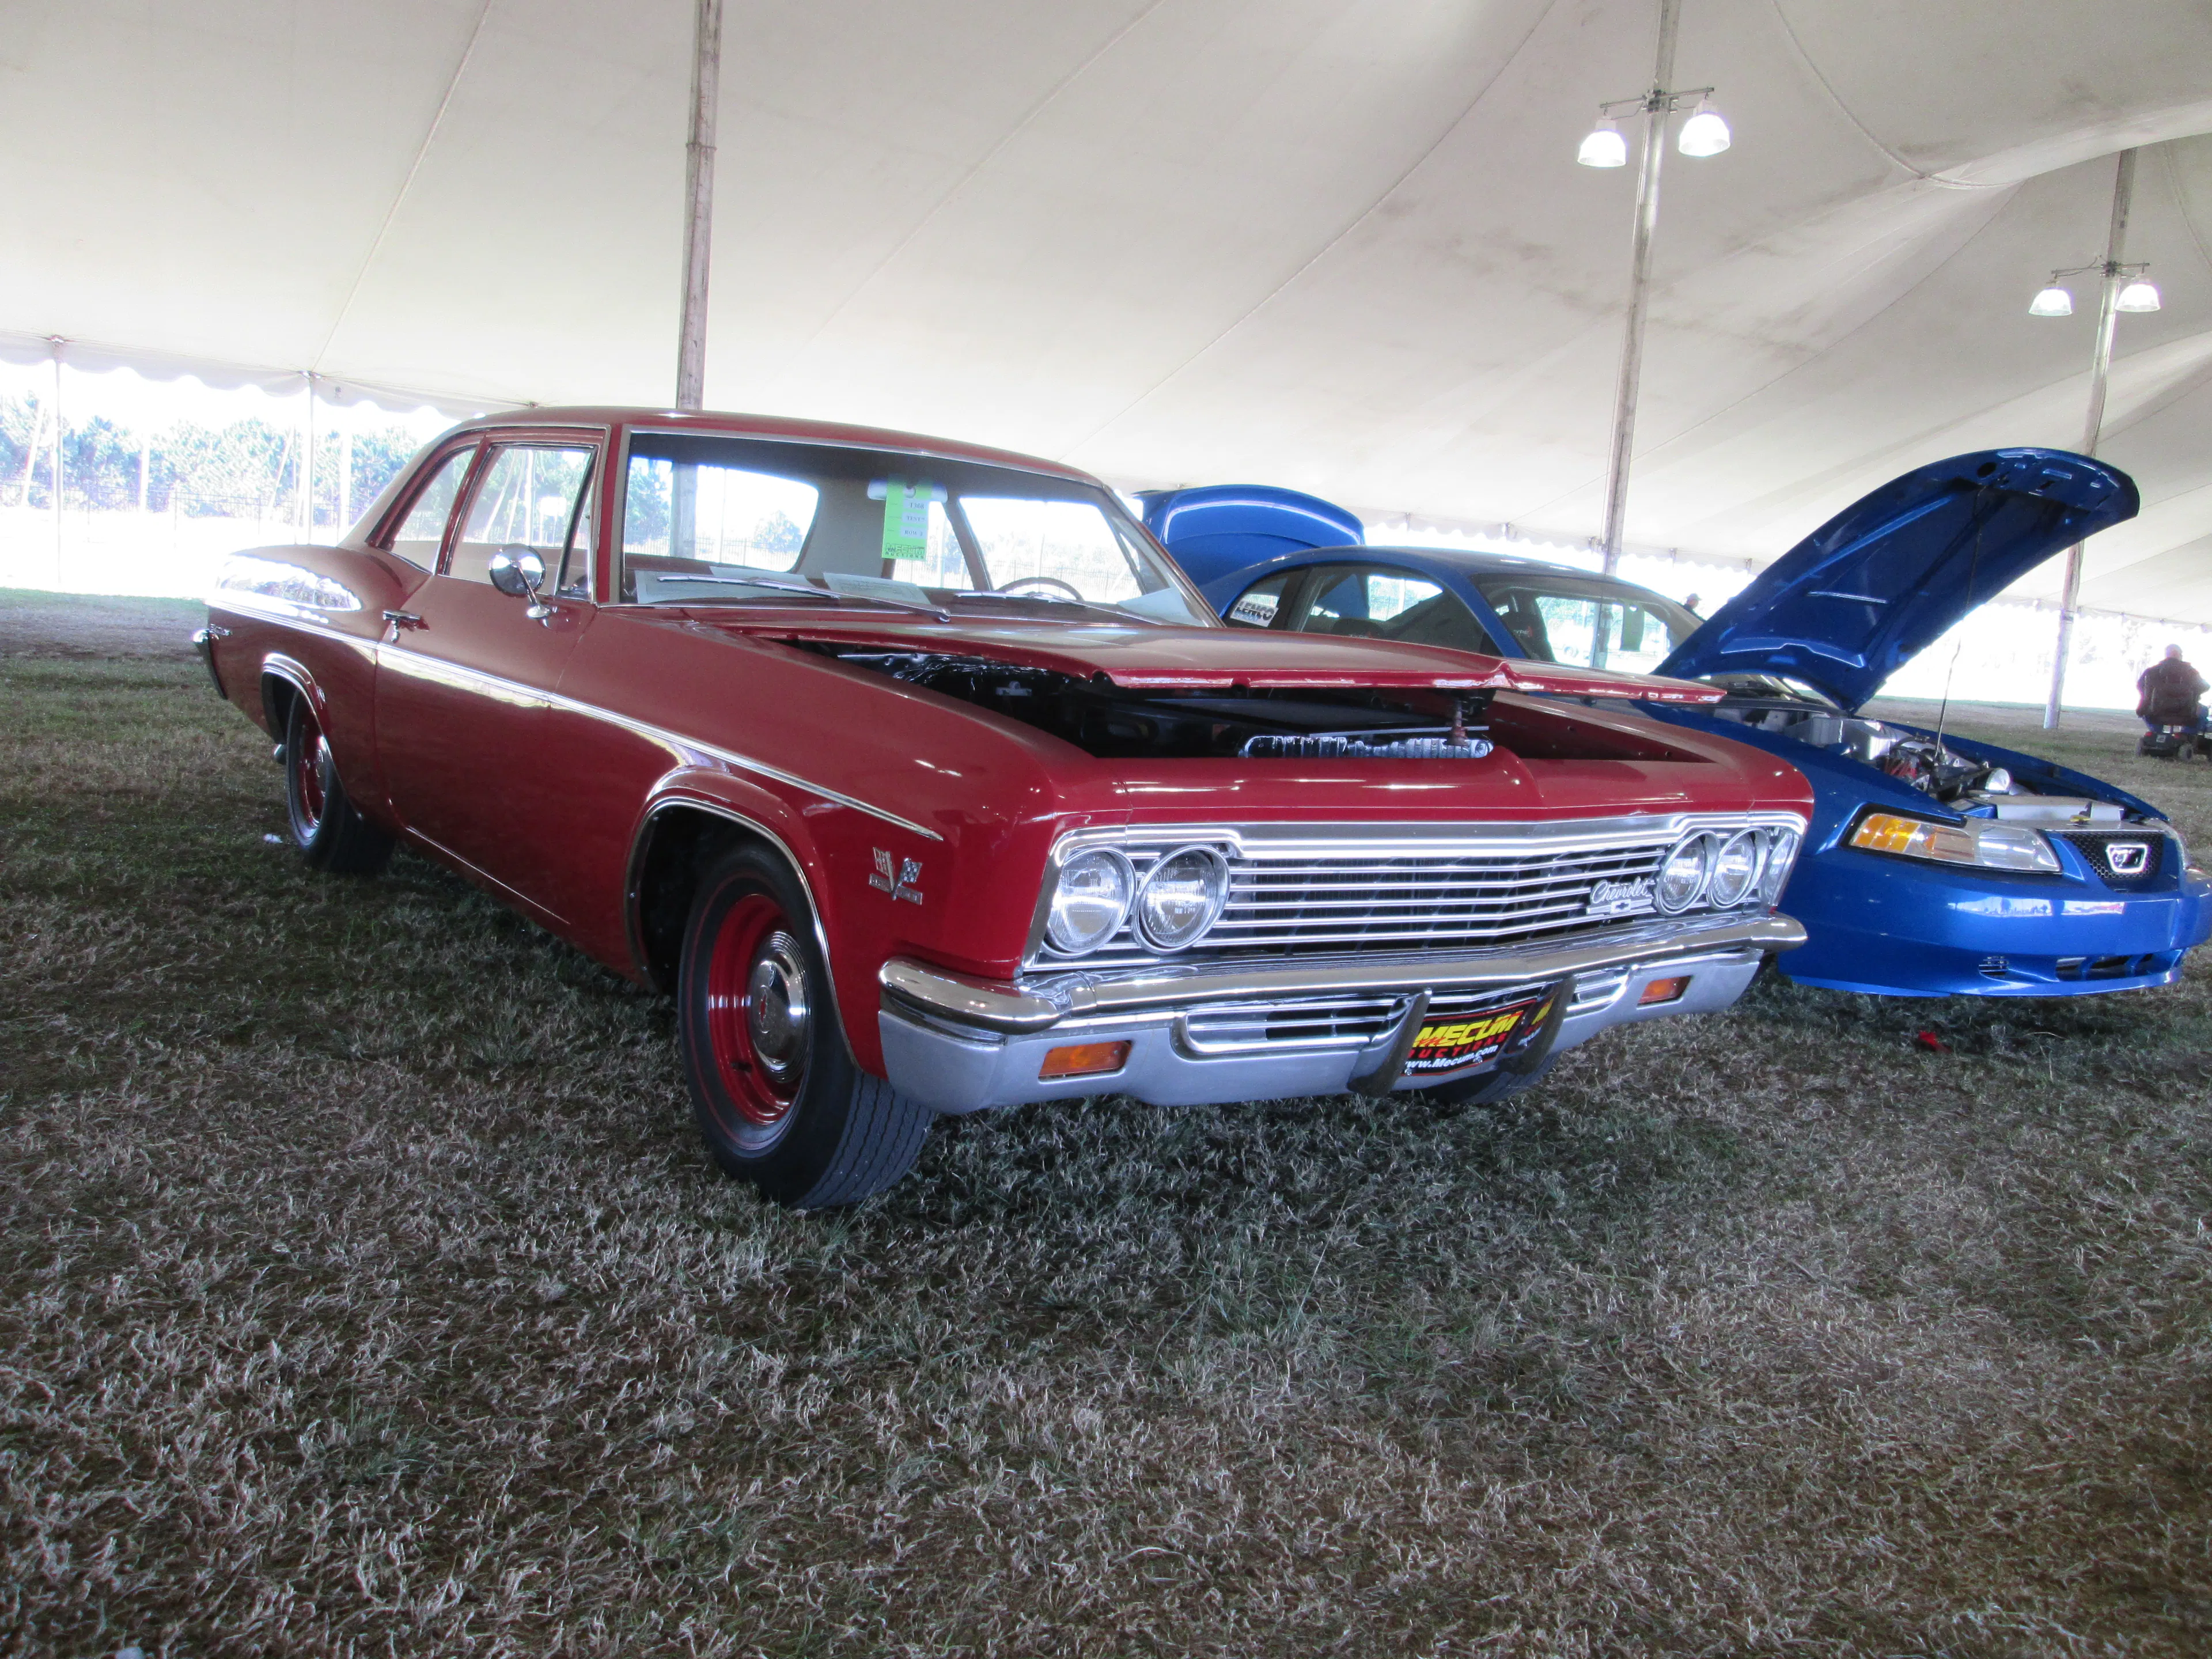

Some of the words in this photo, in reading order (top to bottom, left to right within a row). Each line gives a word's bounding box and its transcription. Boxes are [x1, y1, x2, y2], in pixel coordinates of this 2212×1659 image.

[1236, 601, 1274, 620] LENCO
[1592, 877, 1651, 904] Chevrolet
[1412, 1010, 1524, 1048] MECUM
